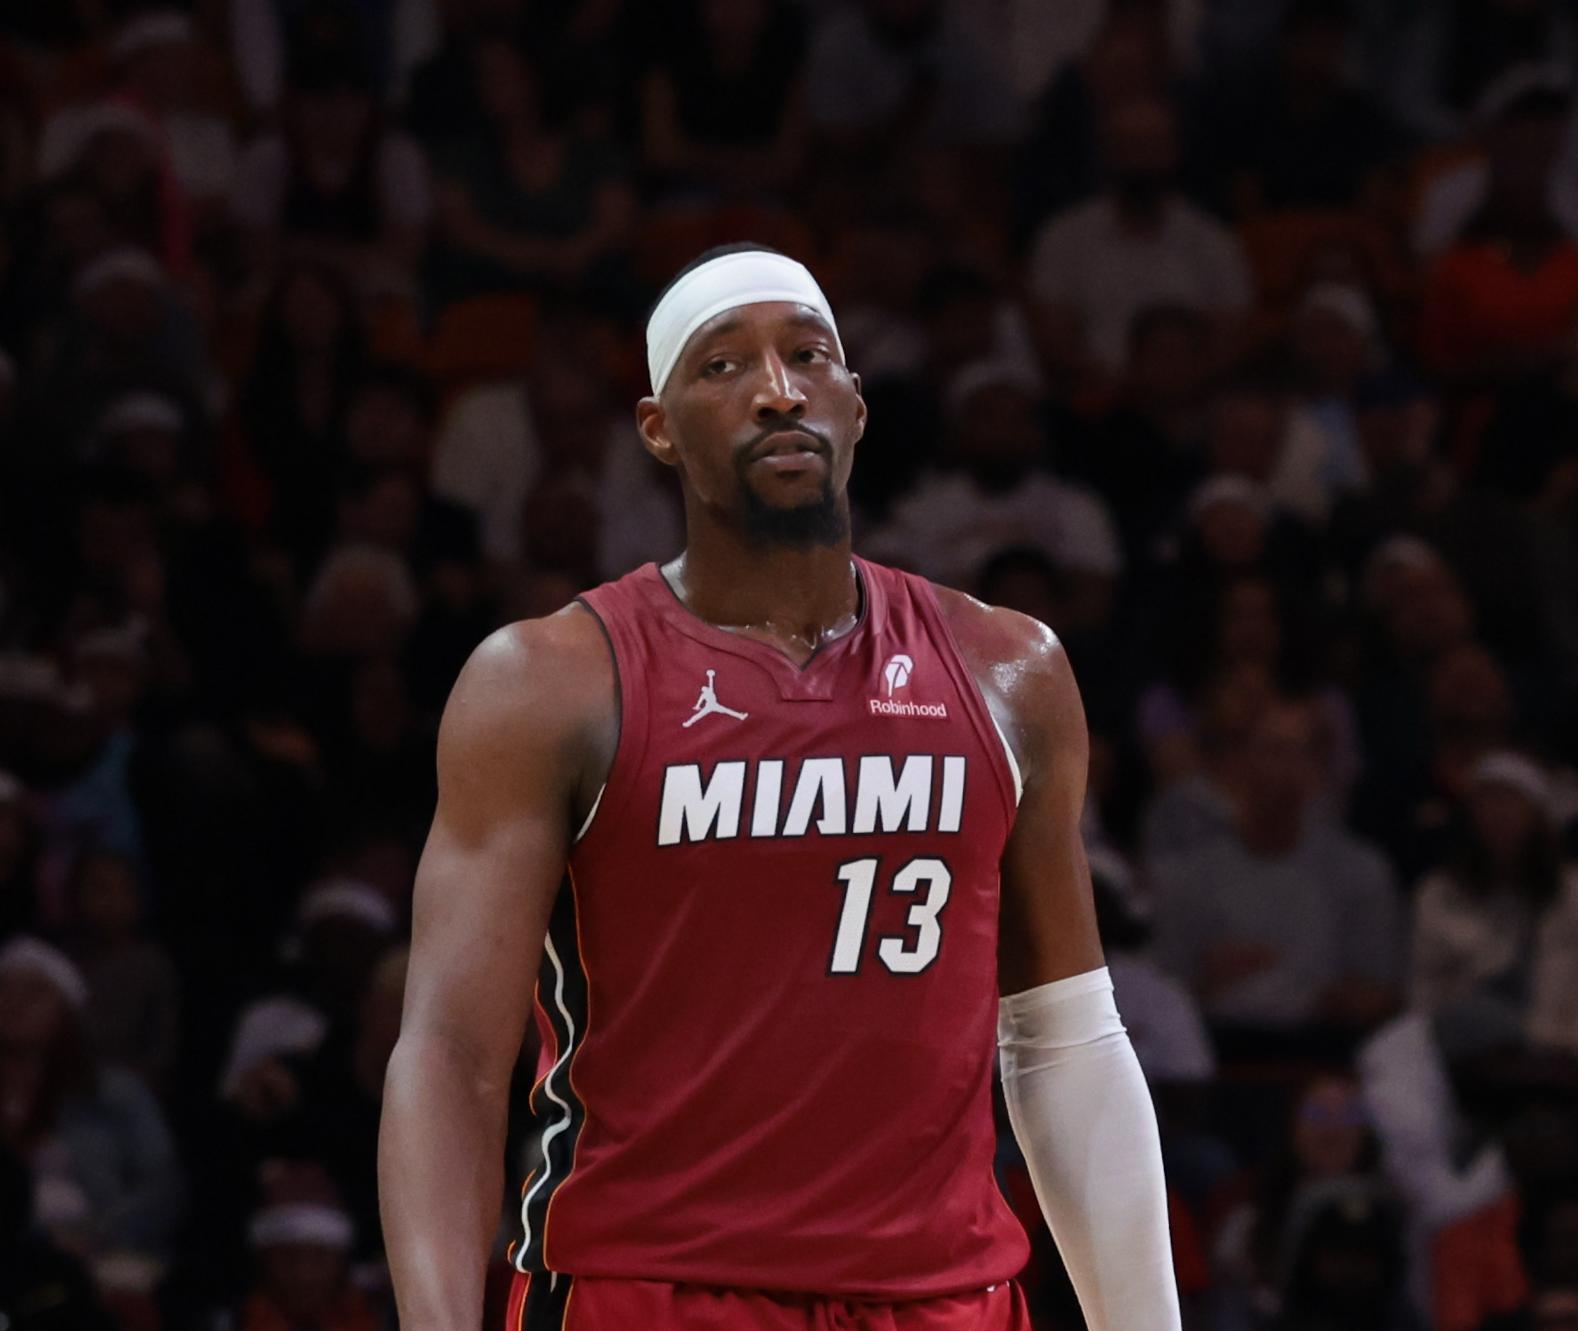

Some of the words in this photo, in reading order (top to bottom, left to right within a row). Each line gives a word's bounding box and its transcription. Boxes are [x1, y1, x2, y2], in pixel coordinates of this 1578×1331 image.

[870, 698, 947, 718] Robinhood
[657, 754, 967, 847] MIAMI
[829, 857, 953, 975] 13
